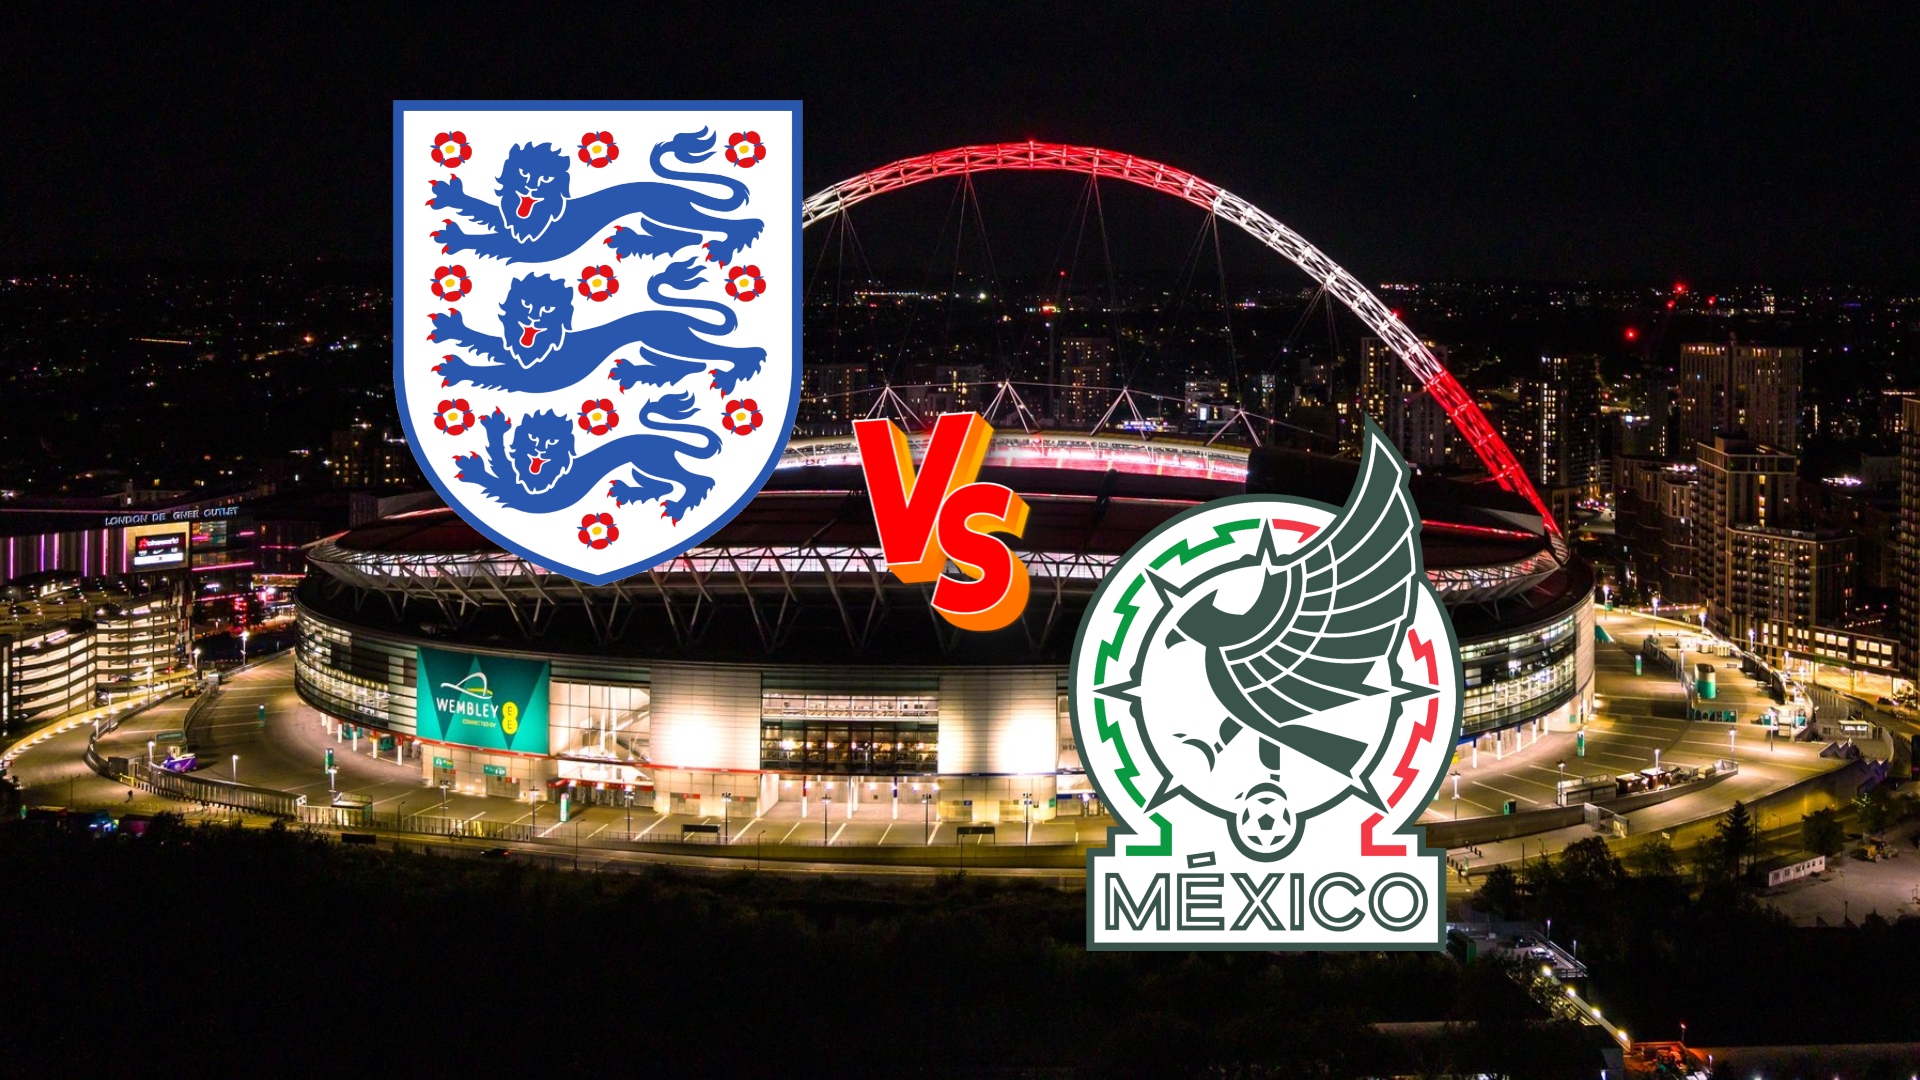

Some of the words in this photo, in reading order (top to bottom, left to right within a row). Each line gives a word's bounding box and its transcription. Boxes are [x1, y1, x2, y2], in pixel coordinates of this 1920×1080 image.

[105, 514, 148, 526] LONDON
[203, 506, 239, 518] OUTLET
[436, 697, 499, 718] WEMBLEY
